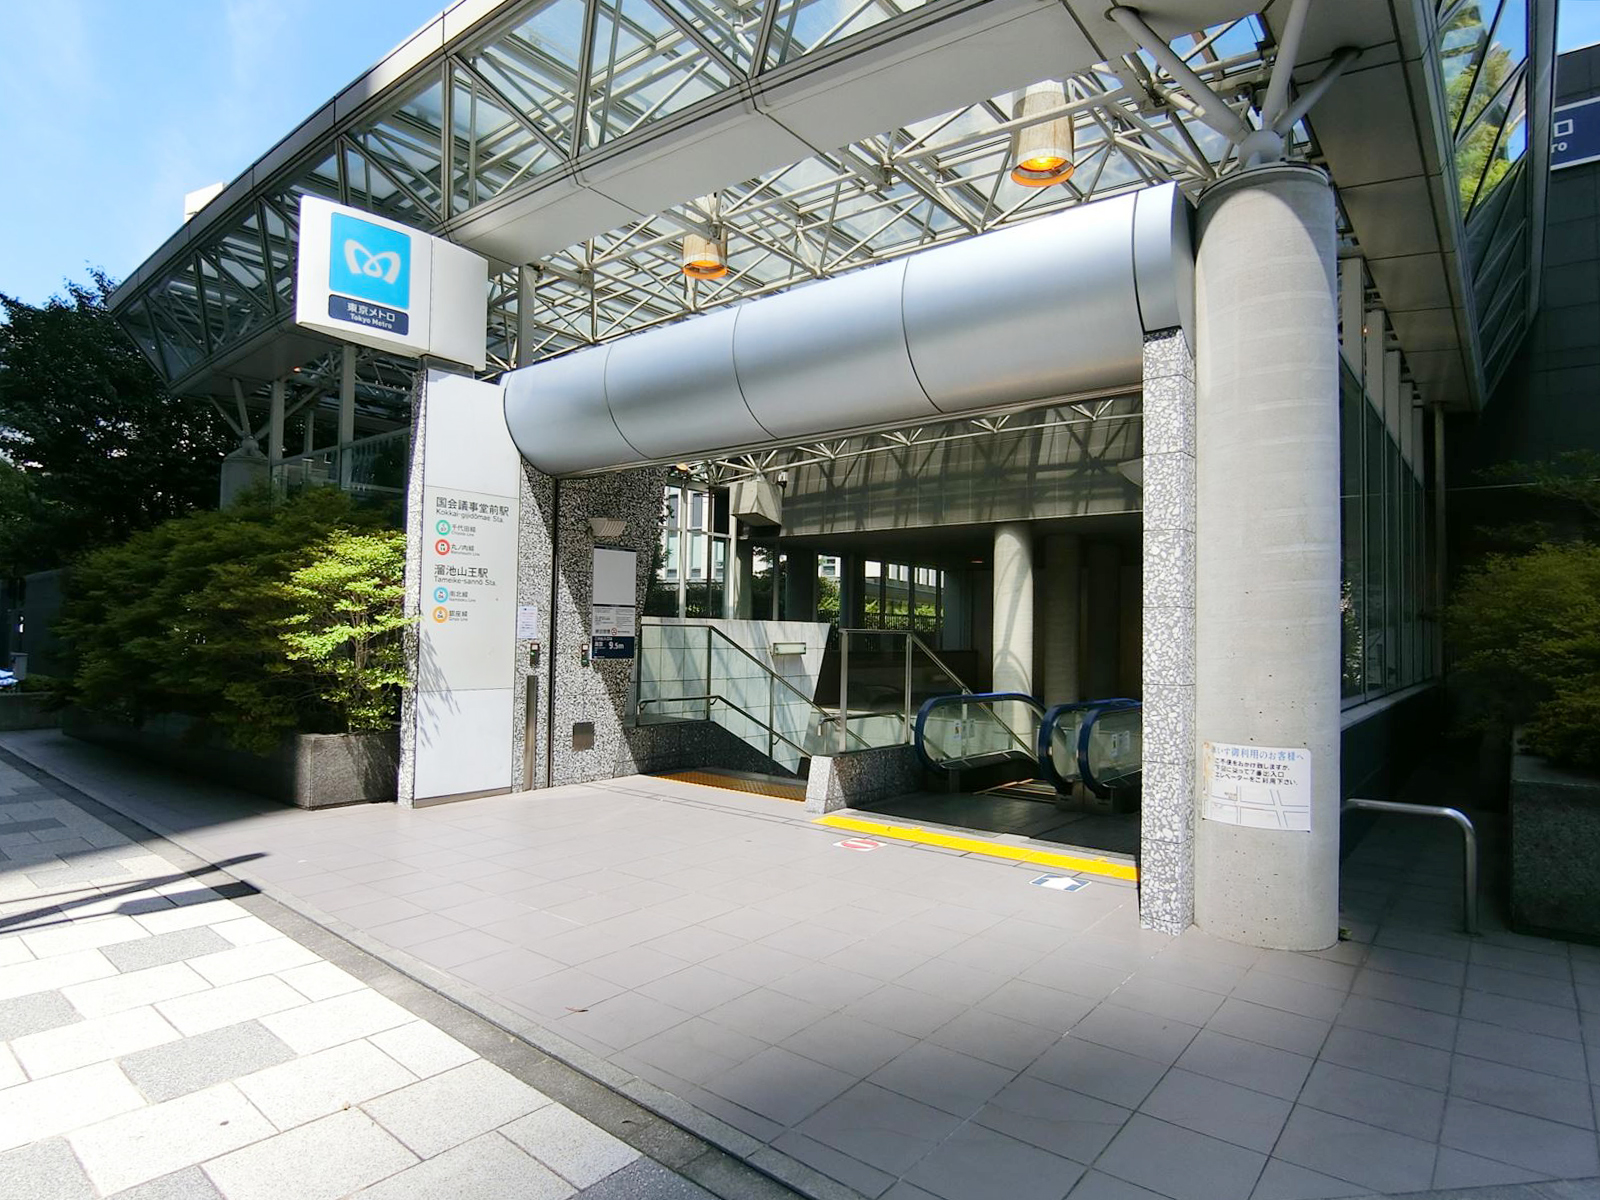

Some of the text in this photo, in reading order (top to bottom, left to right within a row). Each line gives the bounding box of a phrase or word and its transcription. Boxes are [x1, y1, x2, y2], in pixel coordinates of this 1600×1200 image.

[347, 302, 396, 322] 東京メトロ
[350, 313, 393, 329] Tokyo Metro
[436, 496, 510, 517] 国会議事堂前駅
[434, 563, 489, 579] 溜池山王駅
